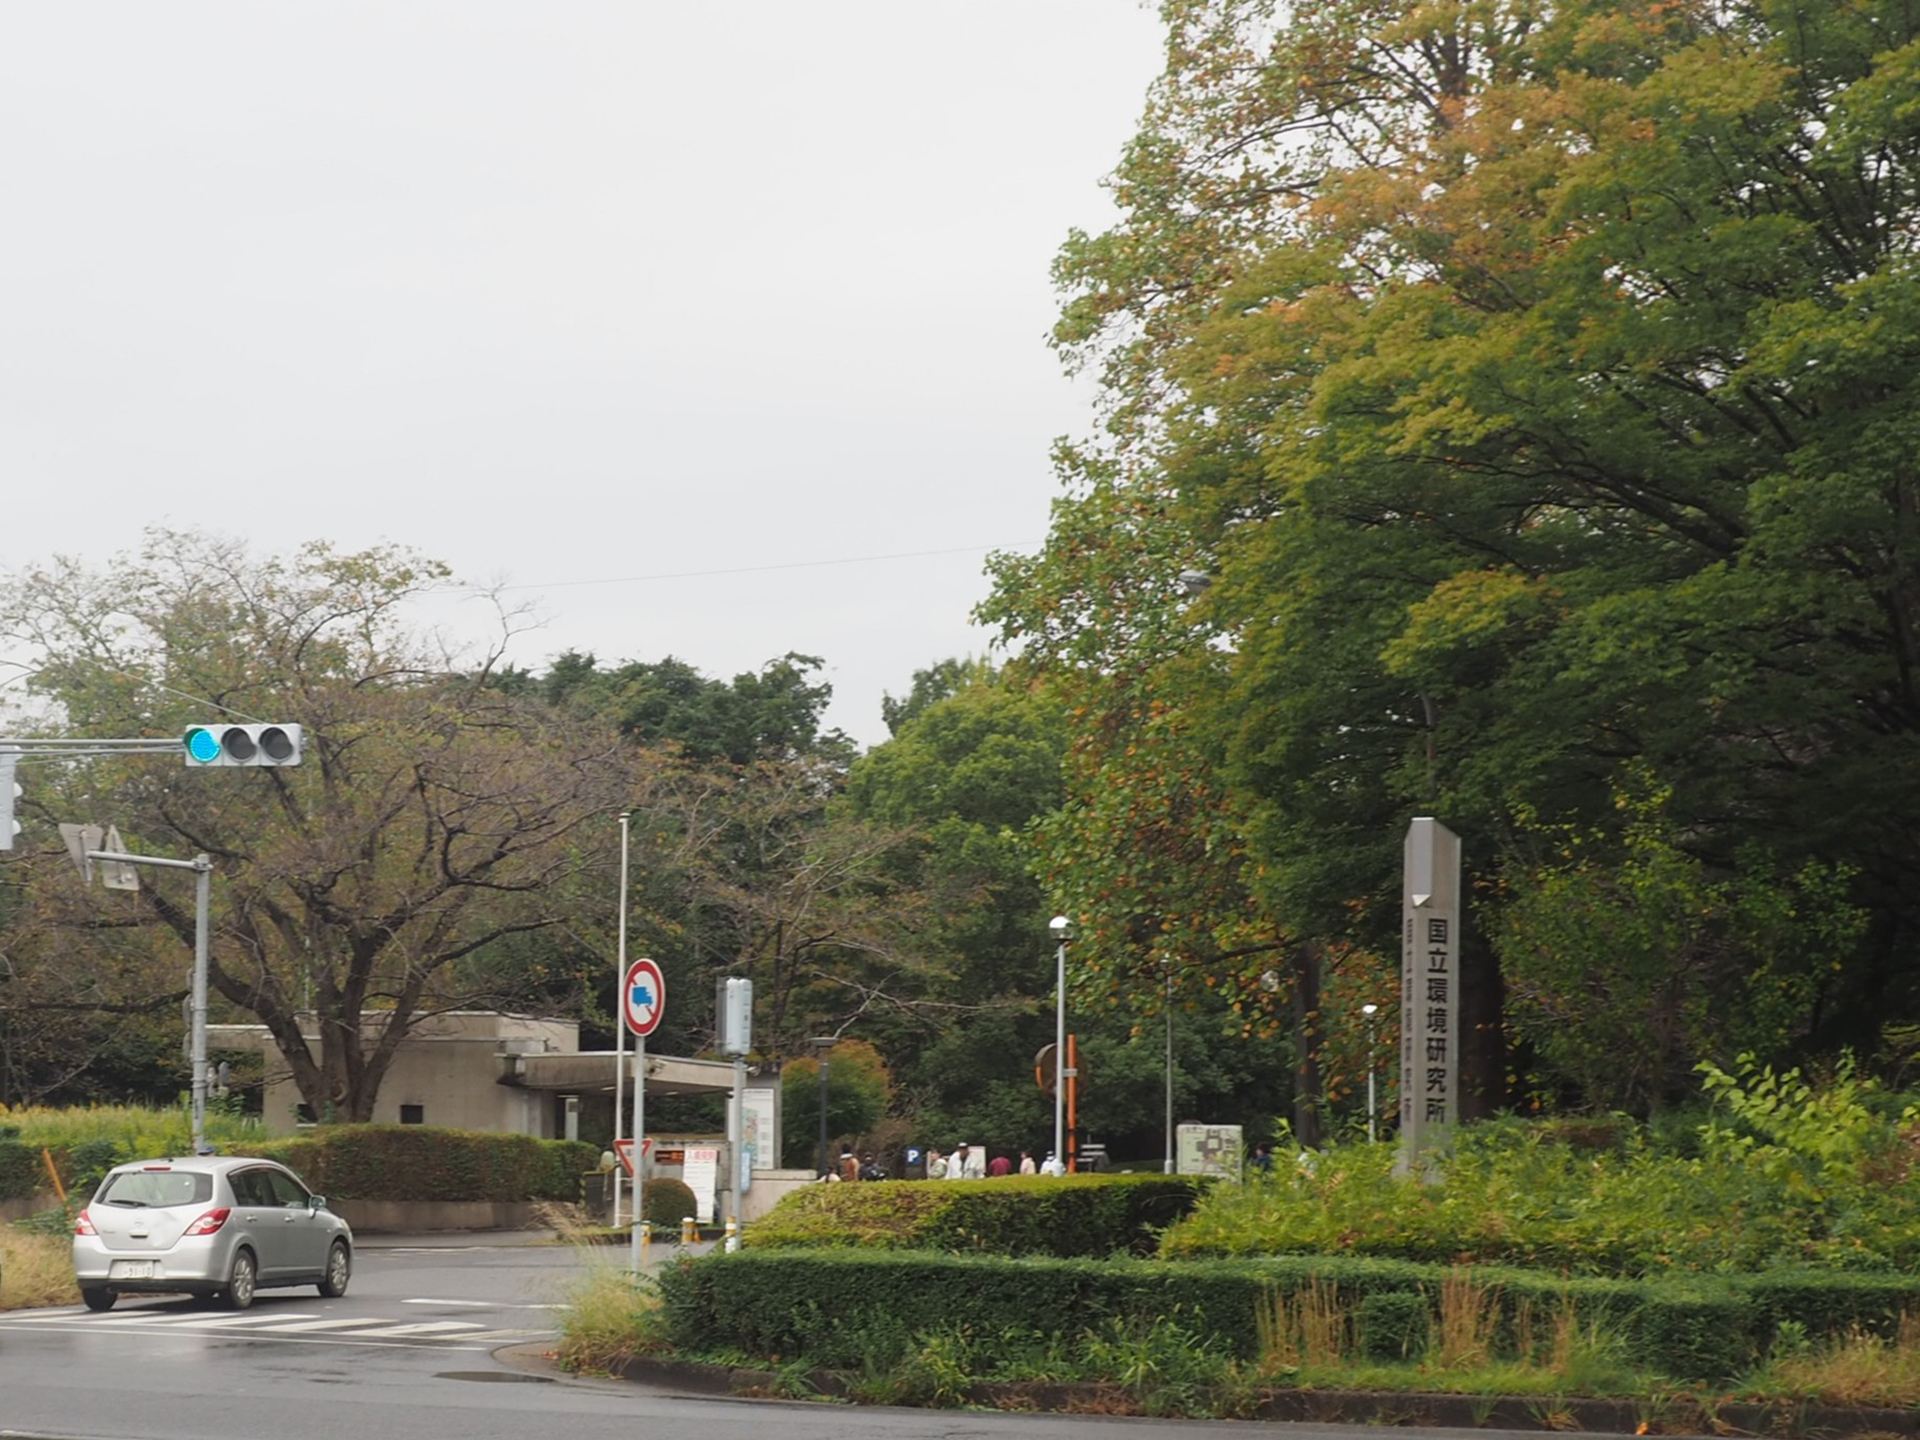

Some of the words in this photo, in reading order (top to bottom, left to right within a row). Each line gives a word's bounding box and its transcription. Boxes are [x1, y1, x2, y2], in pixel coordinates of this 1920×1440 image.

[1425, 918, 1448, 1124] 国立環境研究所
[908, 1149, 919, 1162] P
